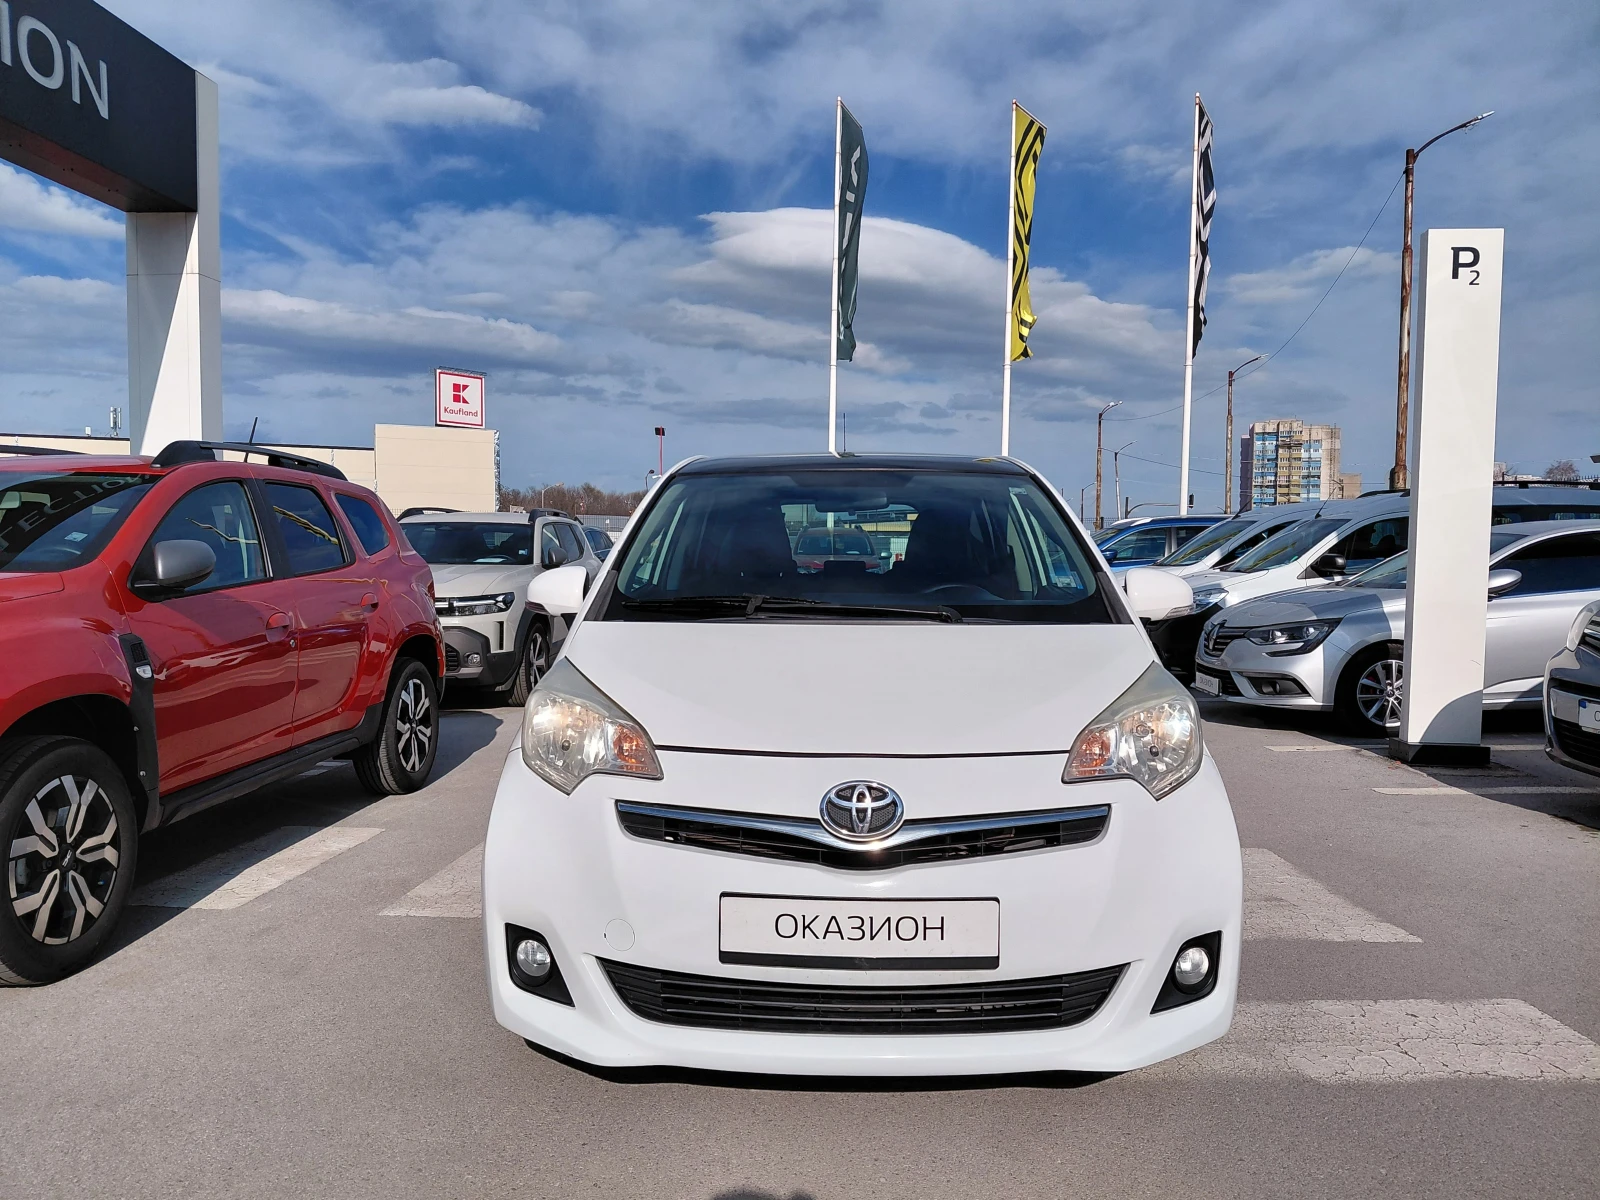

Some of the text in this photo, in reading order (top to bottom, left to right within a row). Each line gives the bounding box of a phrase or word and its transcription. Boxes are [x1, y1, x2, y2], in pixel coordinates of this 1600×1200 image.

[0, 0, 109, 120] ION
[443, 406, 478, 417] Kaufland
[774, 913, 945, 941] ОКАЗИОН
